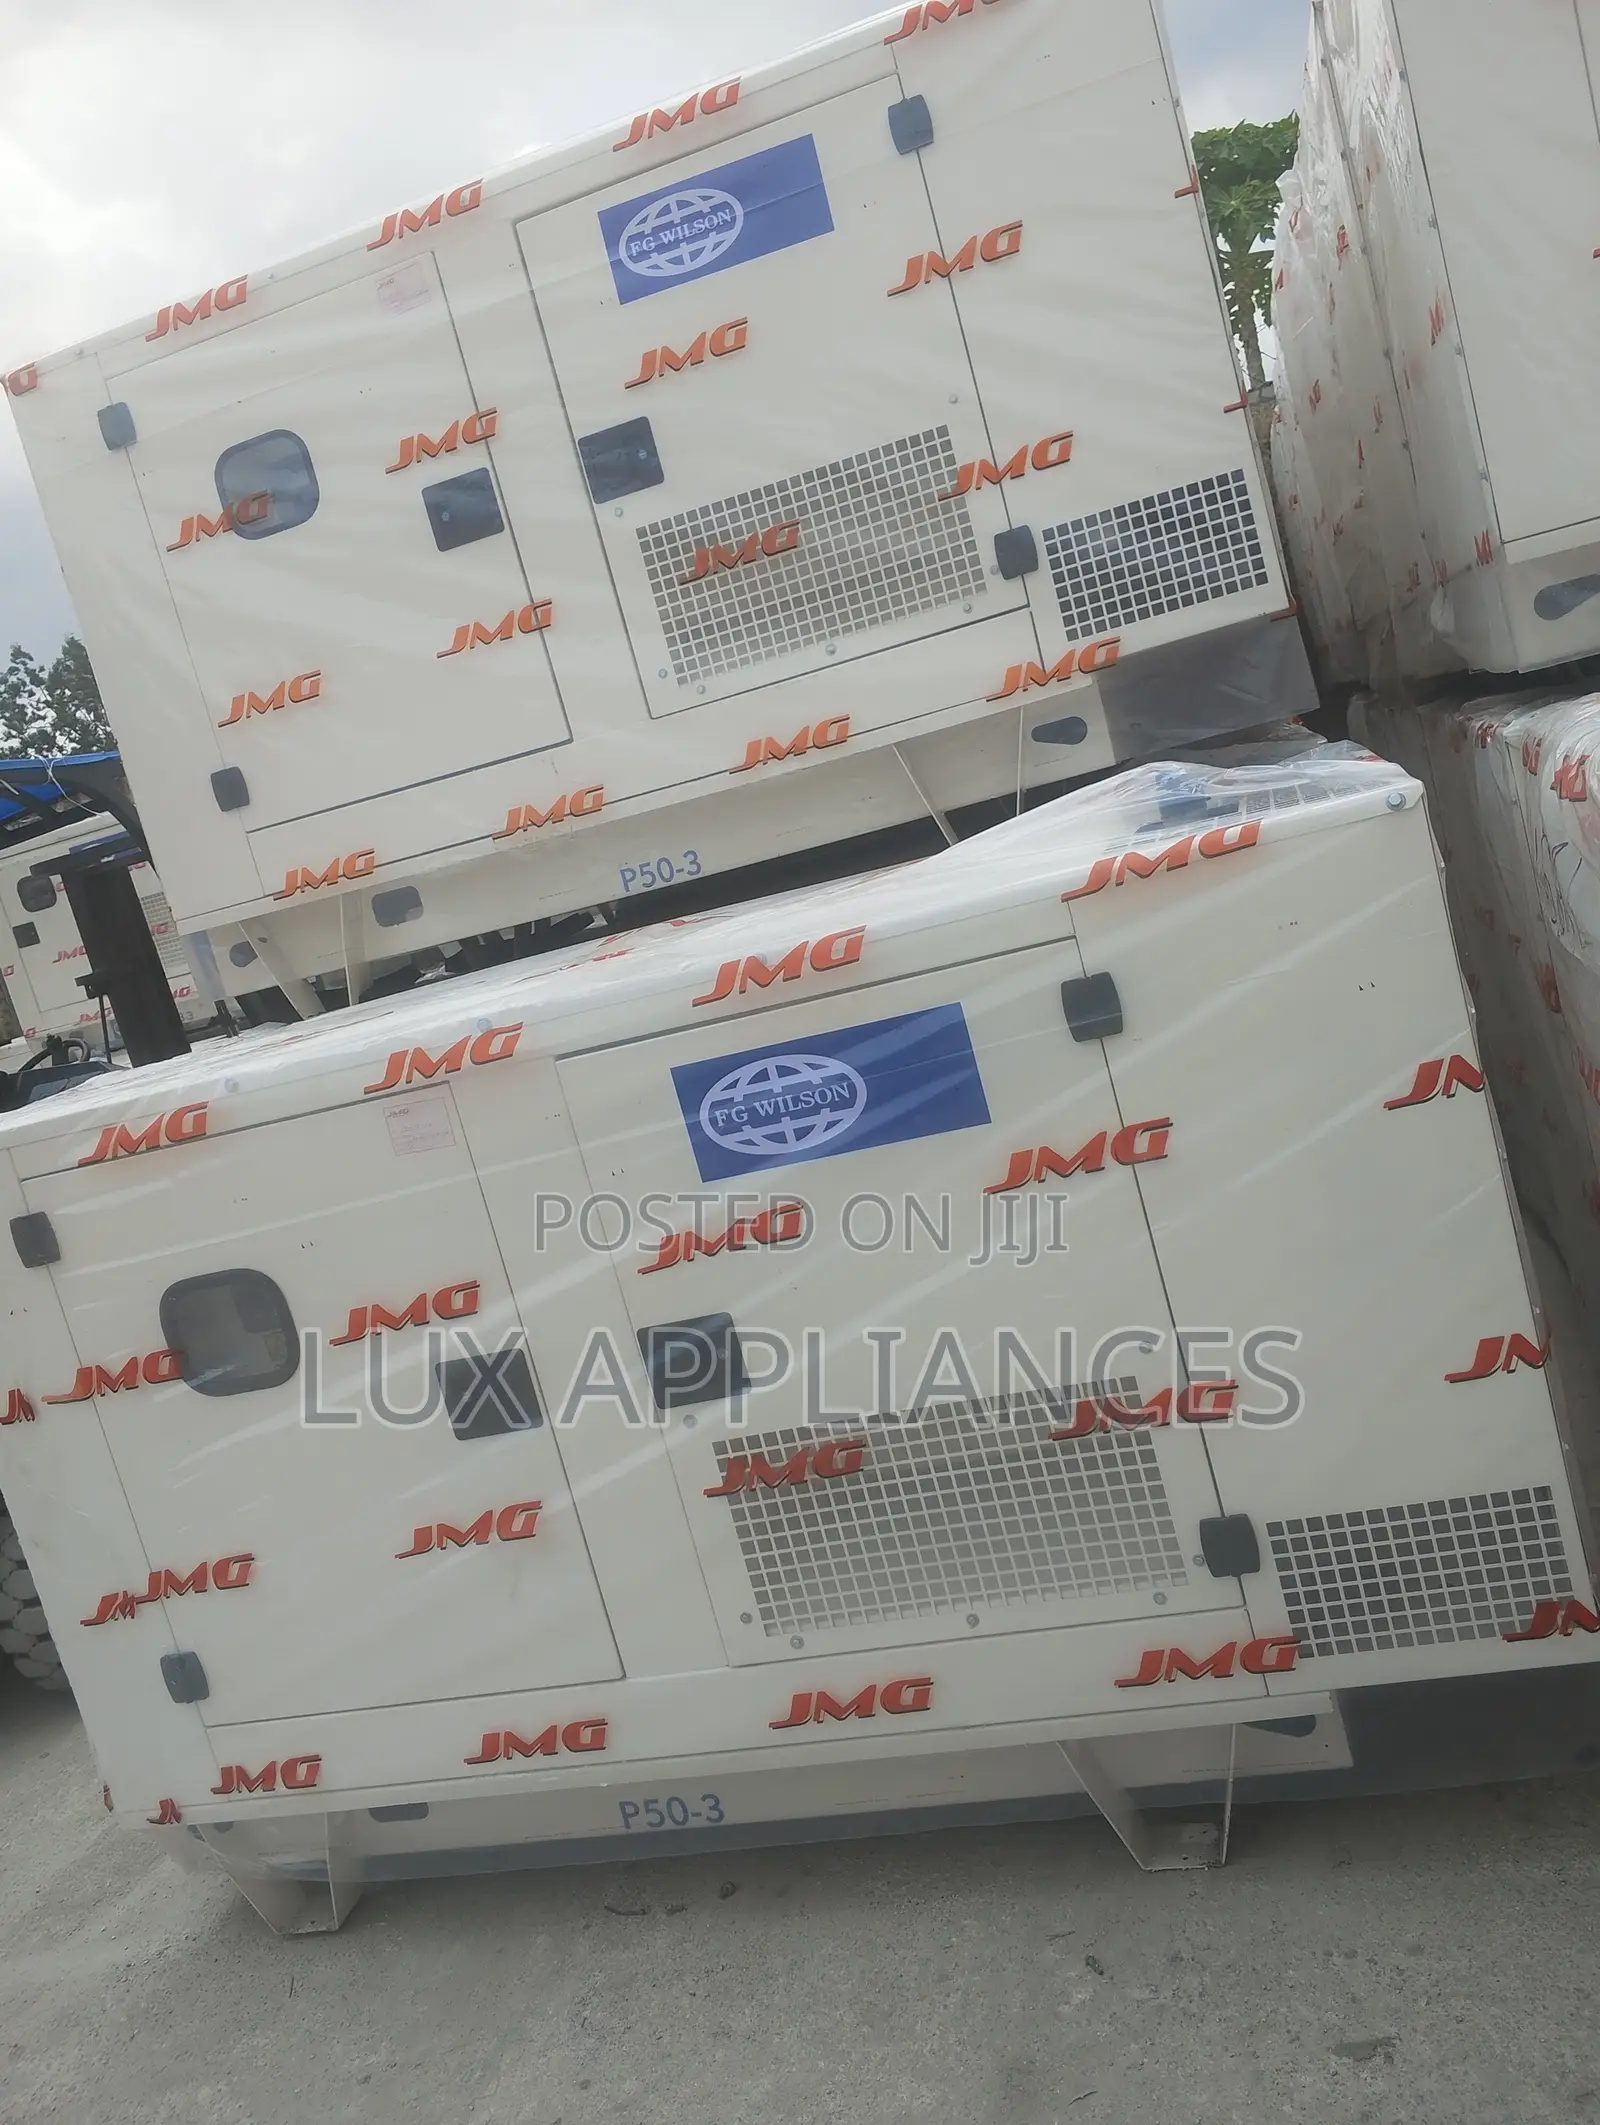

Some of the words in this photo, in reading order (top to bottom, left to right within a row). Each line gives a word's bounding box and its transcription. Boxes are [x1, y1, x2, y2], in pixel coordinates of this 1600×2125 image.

[883, 0, 1003, 46] JM
[612, 76, 742, 152] JMG
[366, 178, 484, 251] JMG
[628, 236, 656, 257] FG
[659, 209, 732, 245] WILSON
[887, 219, 1023, 297] JMG
[144, 274, 249, 342] JMG
[624, 316, 749, 390] JMG
[385, 407, 499, 474] JMG
[938, 430, 1074, 501] JMG
[166, 490, 276, 552] JMG
[678, 519, 801, 585] JMG
[436, 598, 554, 659] JMG
[217, 669, 323, 728] JMG
[986, 635, 1122, 702] JMG
[729, 713, 851, 774] JMG
[491, 783, 605, 840] JMG
[273, 848, 375, 900] JMG
[619, 850, 703, 893] P50-3
[1060, 819, 1263, 902] JMG
[692, 924, 867, 1007] JMG
[364, 1020, 524, 1095] JMG
[78, 1100, 210, 1168] JMG
[714, 1105, 749, 1128] FG
[754, 1083, 850, 1117] WILSON
[983, 1116, 1175, 1196] JMG
[637, 1200, 804, 1275] JMG
[329, 1279, 481, 1346] JMG
[41, 1347, 186, 1405] JMG
[1048, 1379, 1240, 1441] JMG
[704, 1438, 865, 1498] JMG
[394, 1499, 542, 1559] JMG
[134, 1552, 255, 1606] JMG
[1114, 1635, 1300, 1689] JMG
[769, 1676, 934, 1727] JMG
[464, 1718, 609, 1766] JMG
[210, 1753, 322, 1796] JMG
[618, 1793, 726, 1830] P50-3
